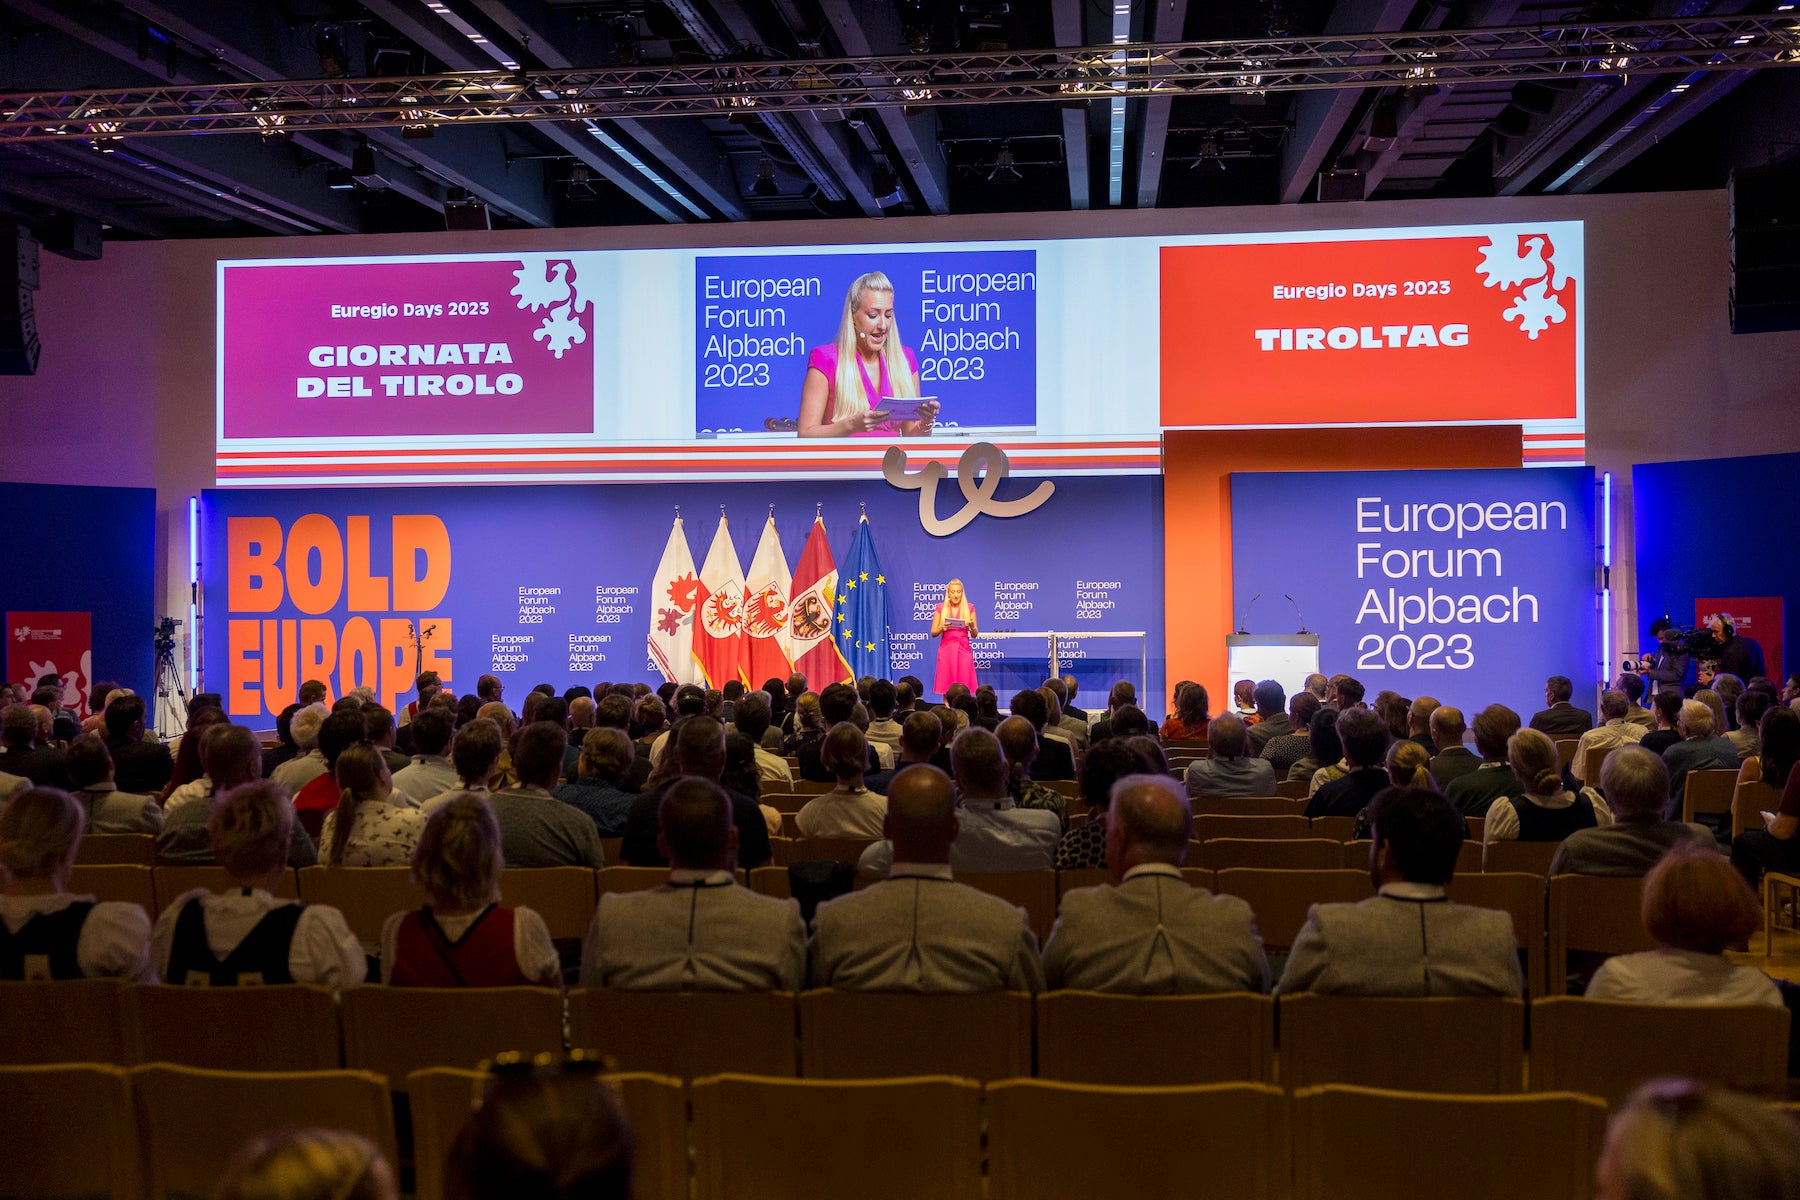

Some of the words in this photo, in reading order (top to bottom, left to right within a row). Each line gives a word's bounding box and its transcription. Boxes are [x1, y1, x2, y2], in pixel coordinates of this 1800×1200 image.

[922, 270, 1035, 296] European
[706, 276, 820, 302] European
[1274, 283, 1346, 300] Euregio
[1353, 284, 1397, 298] Days
[1404, 281, 1450, 295] 2023
[332, 303, 398, 319] Euregio
[404, 304, 442, 318] Days
[448, 302, 489, 315] 2023
[922, 300, 1000, 322] Forum
[706, 306, 785, 328] Forum
[920, 327, 1019, 356] Alpbach
[1255, 324, 1468, 350] TIROLTAG
[704, 332, 804, 362] Alpbach
[309, 343, 512, 367] GIORNATA
[921, 357, 984, 380] 2023
[705, 363, 770, 387] 2023
[297, 377, 372, 398] DEL
[380, 374, 523, 396] TIROLO
[1357, 497, 1566, 538] European
[228, 514, 451, 614] BOLD
[1358, 543, 1501, 578] Forum
[914, 583, 948, 592] Europe
[995, 582, 1038, 592] European
[1077, 581, 1120, 590] European
[519, 587, 561, 596] European
[596, 586, 638, 596] European
[995, 591, 1026, 600] Forum
[1077, 590, 1108, 599] Forum
[519, 596, 549, 605] Forum
[596, 595, 626, 604] Forum
[914, 592, 944, 601] Forum
[596, 604, 633, 614] Alpbach
[913, 602, 936, 612] Alpb
[994, 600, 1033, 610] Alpbach
[1076, 600, 1115, 610] Alpbach
[1355, 587, 1538, 631] Alpbach
[518, 606, 556, 616] Alpbach
[995, 610, 1020, 619] 2023
[1077, 610, 1102, 618] 2023
[519, 616, 544, 624] 2023
[596, 614, 620, 623] 2023
[913, 612, 933, 621] 202
[492, 635, 534, 644] European
[569, 634, 611, 644] European
[889, 632, 928, 641] uropean
[492, 644, 522, 653] Forum
[569, 643, 599, 652] Forum
[1357, 634, 1474, 669] 2023
[492, 654, 529, 664] Alpbach
[568, 652, 606, 662] Alpbach
[972, 650, 1005, 661] lpbach
[228, 616, 453, 717] EUROPE
[492, 664, 516, 672] 2023
[569, 662, 594, 671] 2023
[891, 661, 910, 669] 023
[974, 660, 991, 669] 023
